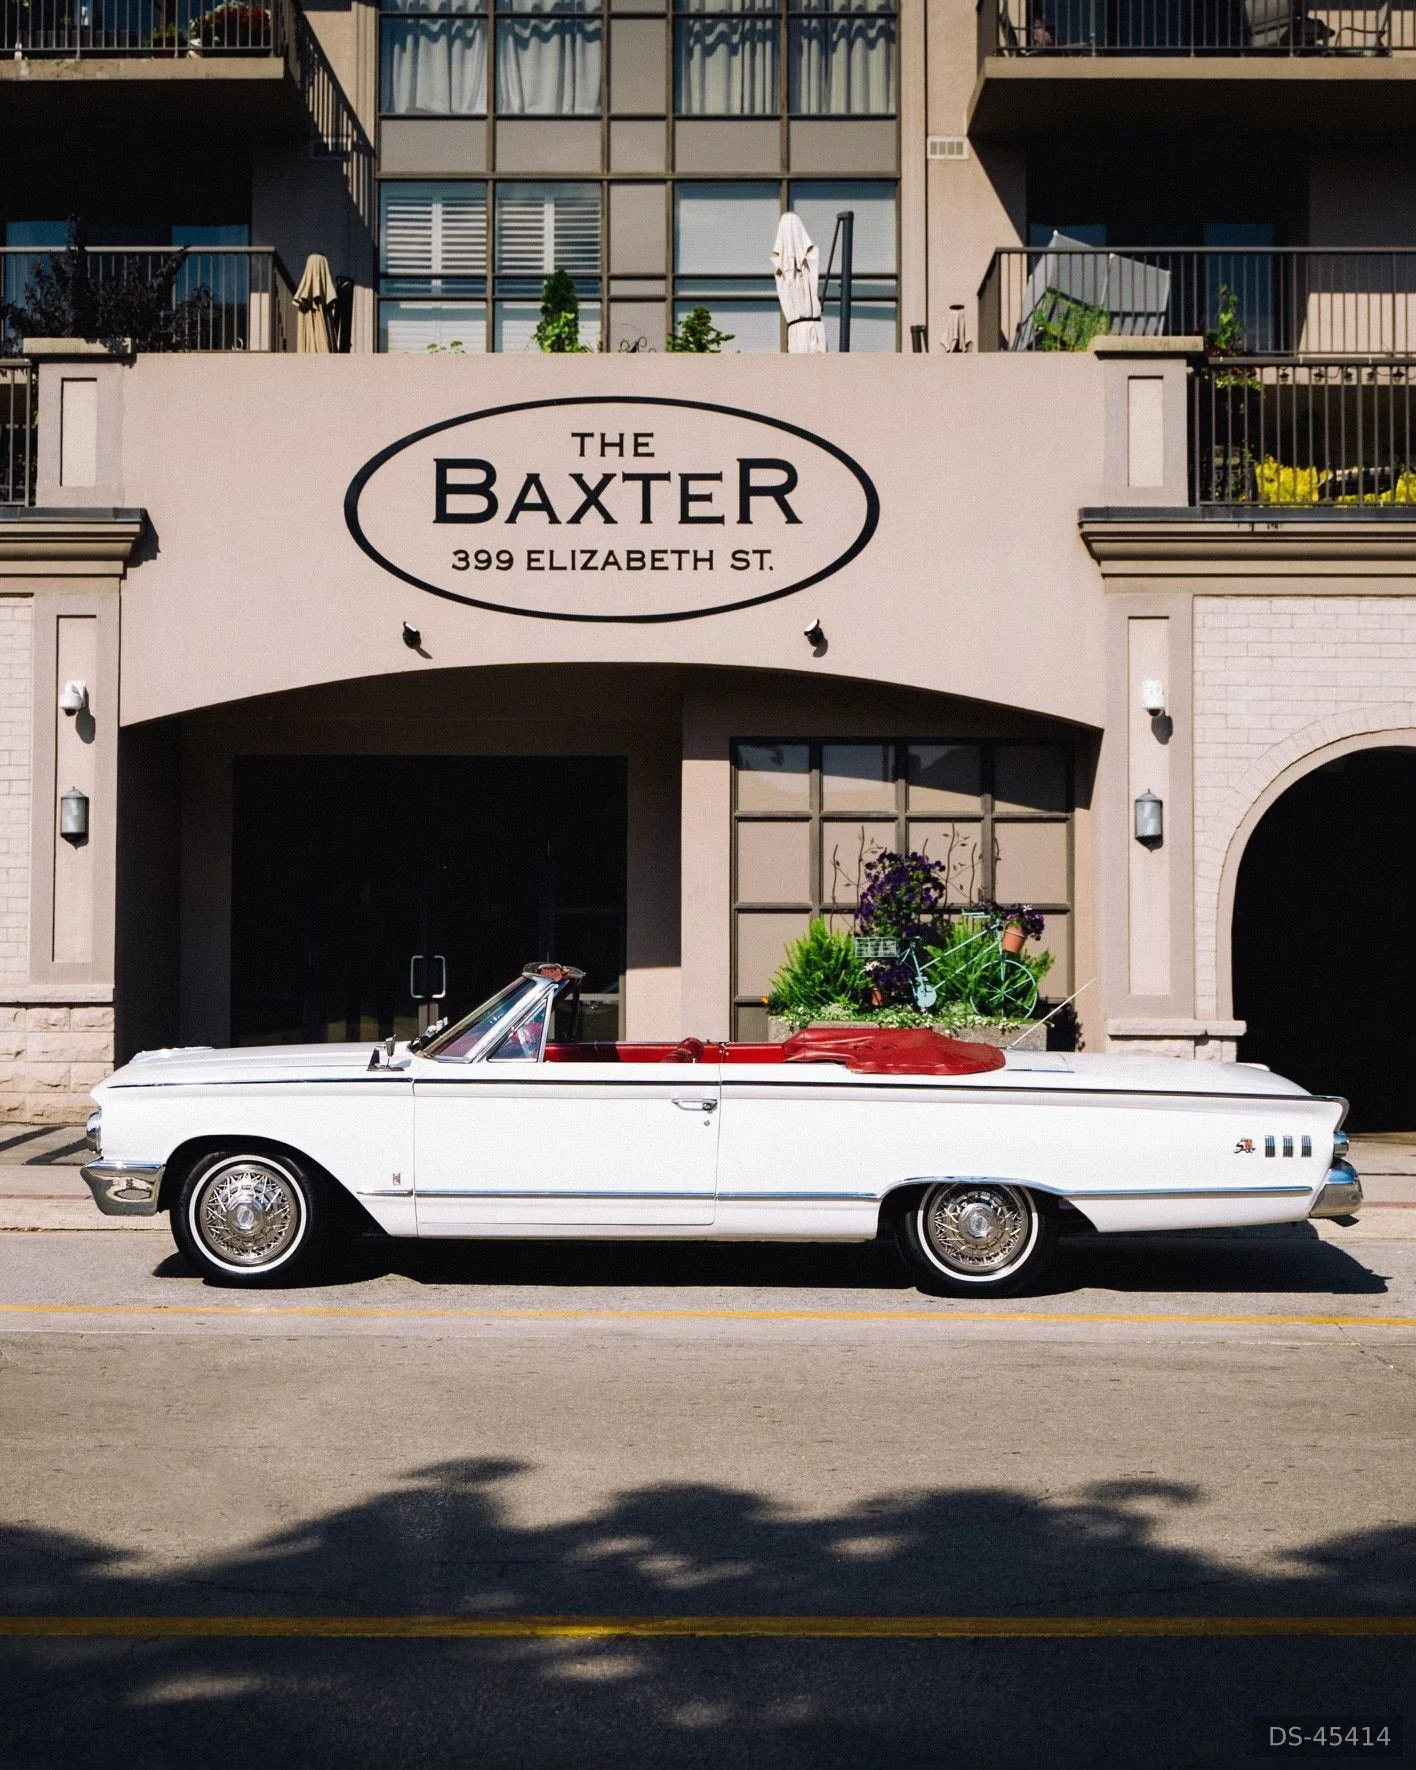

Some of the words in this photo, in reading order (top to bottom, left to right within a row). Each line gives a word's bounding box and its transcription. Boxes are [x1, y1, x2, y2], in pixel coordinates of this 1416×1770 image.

[570, 431, 655, 458] THE
[432, 458, 803, 526] BAXTER
[451, 549, 514, 572] 399
[526, 549, 714, 571] ELIZABETH
[730, 549, 774, 571] ST.
